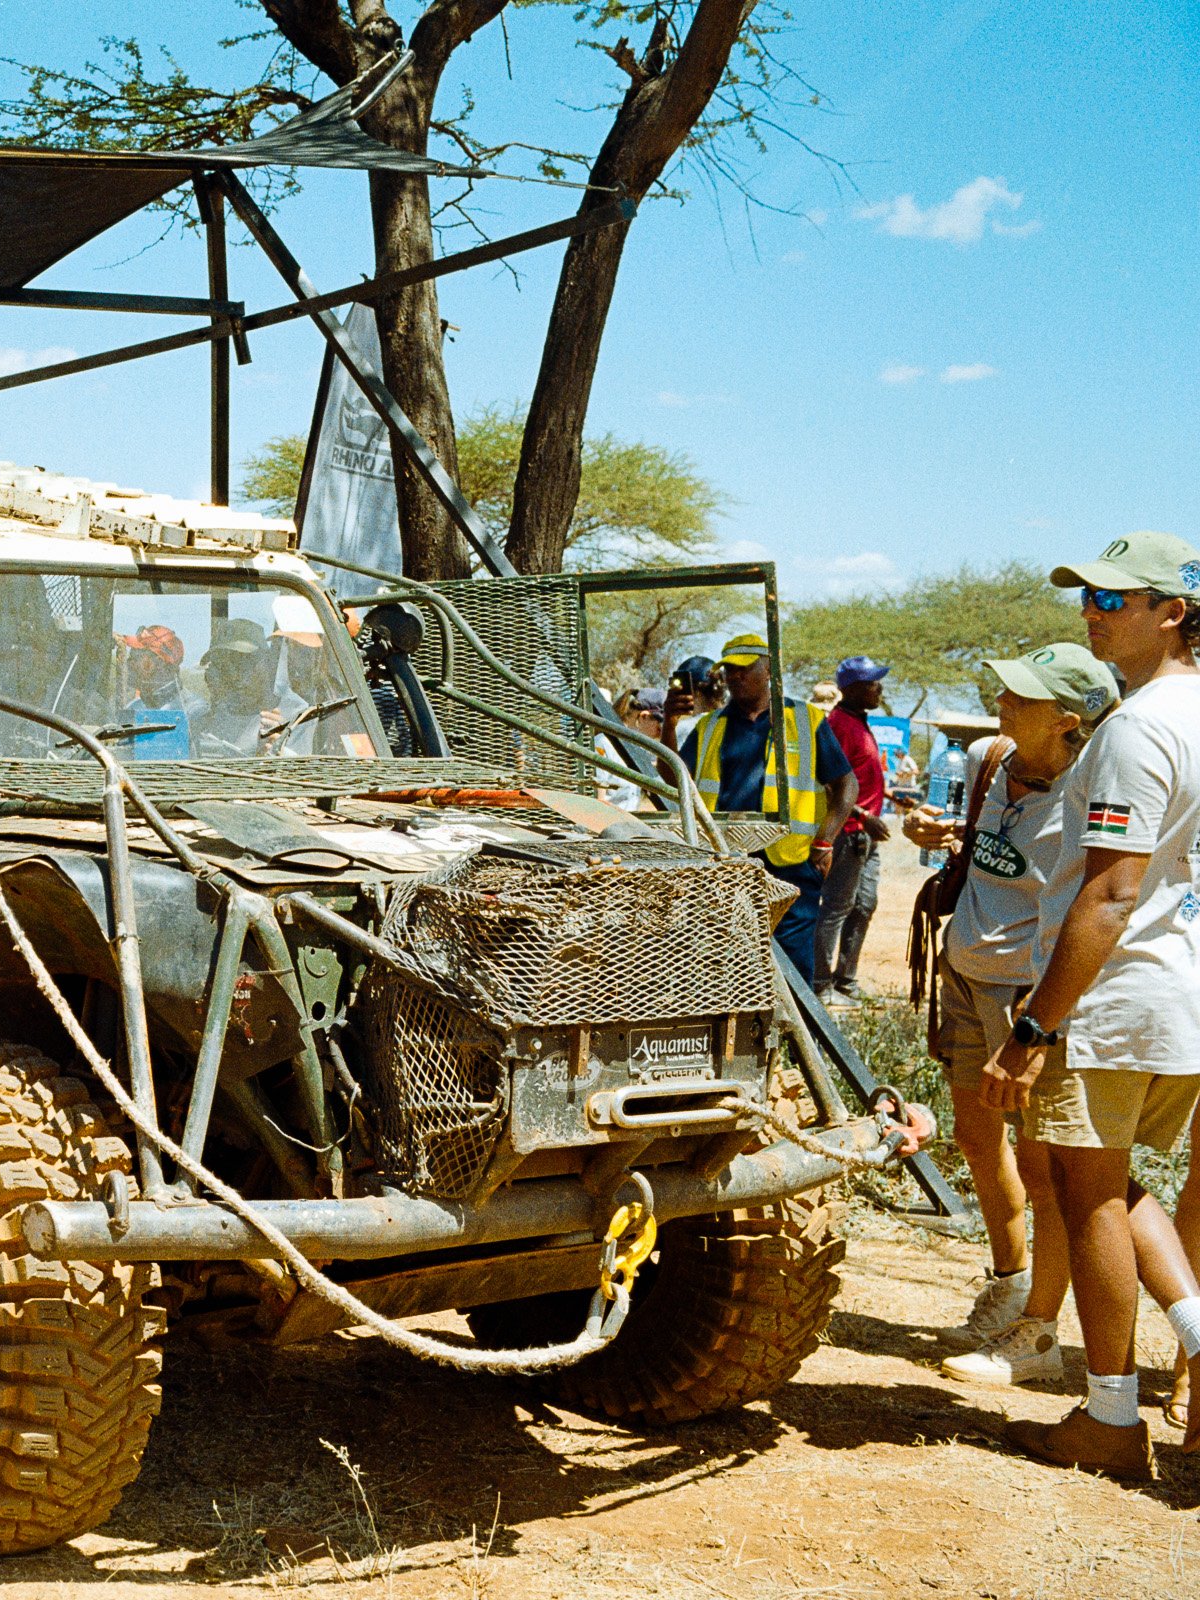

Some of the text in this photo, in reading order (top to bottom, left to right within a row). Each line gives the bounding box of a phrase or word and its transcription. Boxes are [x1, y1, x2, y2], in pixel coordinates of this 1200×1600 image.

[332, 446, 376, 472] RHINO
[975, 847, 1017, 876] ROVER
[632, 1033, 709, 1062] Aquamist
